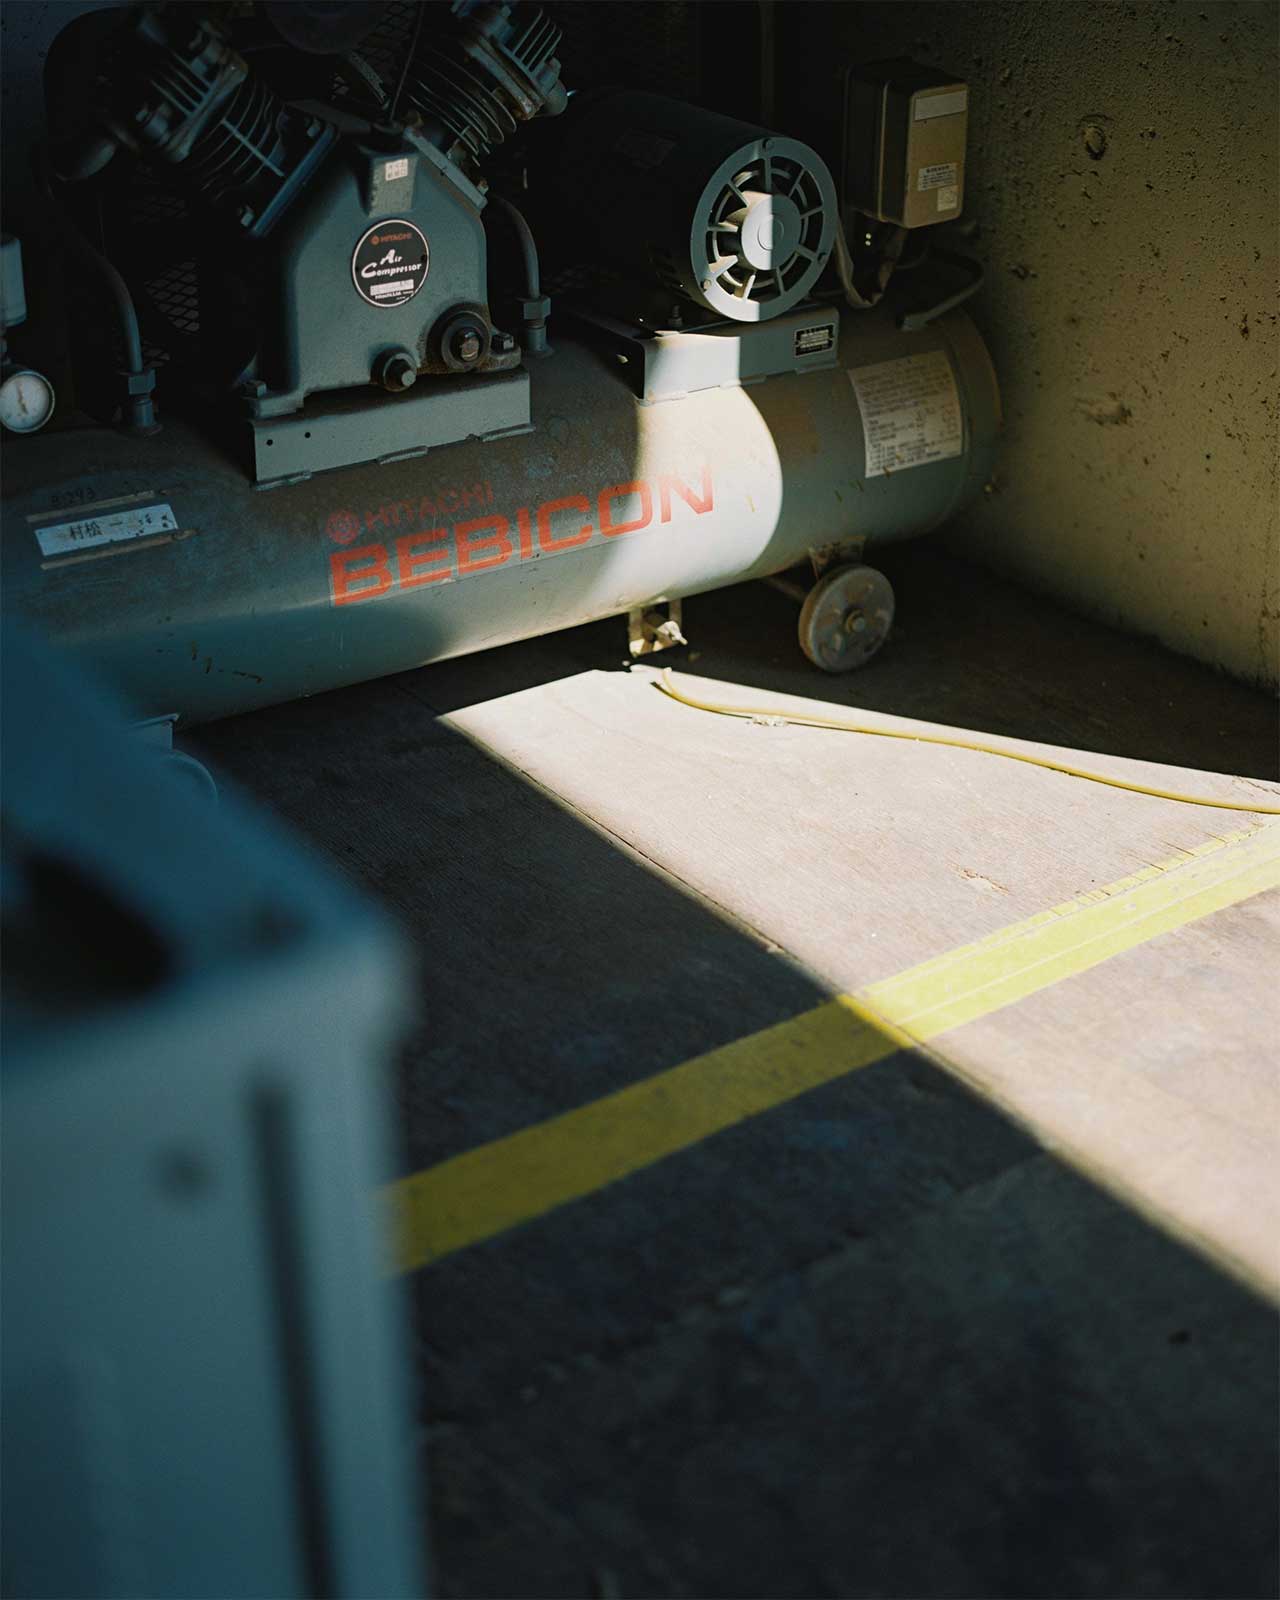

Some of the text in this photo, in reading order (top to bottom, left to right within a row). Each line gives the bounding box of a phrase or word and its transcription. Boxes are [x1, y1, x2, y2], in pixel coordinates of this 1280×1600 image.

[361, 262, 422, 278] Compressor
[380, 248, 403, 265] Air
[364, 480, 494, 529] HITACHI
[329, 465, 714, 607] BEBICON
